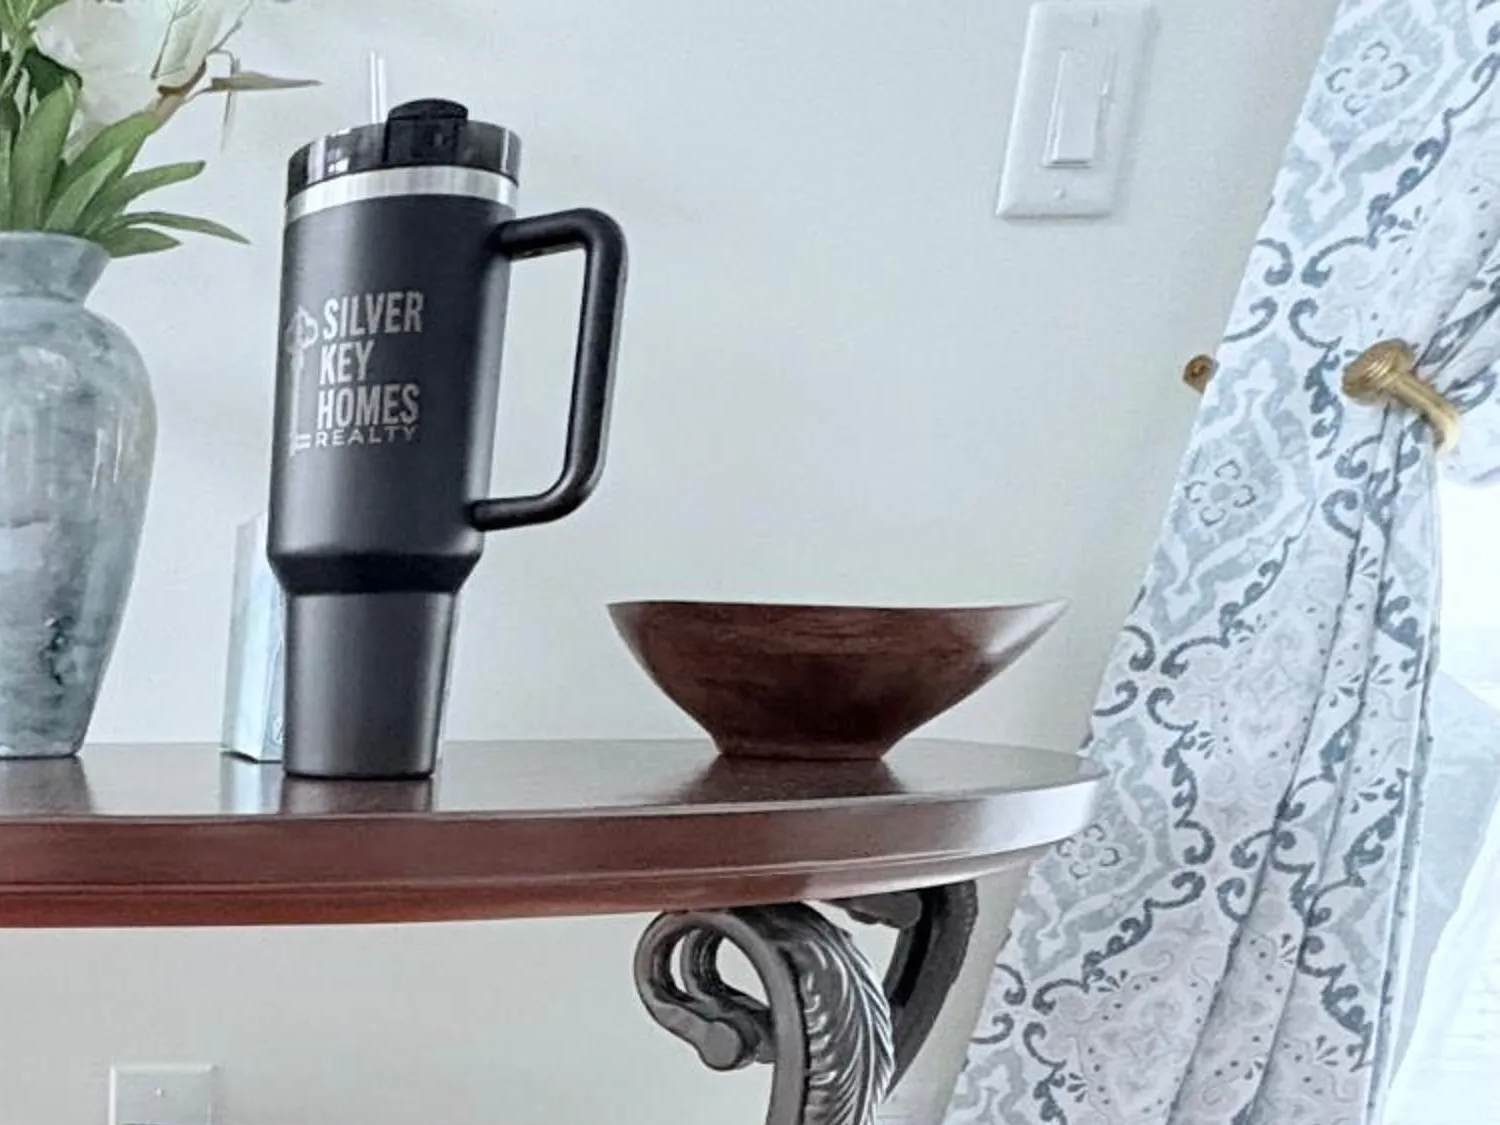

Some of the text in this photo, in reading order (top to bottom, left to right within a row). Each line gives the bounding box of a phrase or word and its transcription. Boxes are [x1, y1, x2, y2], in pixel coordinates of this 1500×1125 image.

[322, 290, 425, 340] SILVER
[319, 339, 376, 385] KEY
[316, 384, 420, 430] HOMES
[314, 425, 417, 448] REALTY
